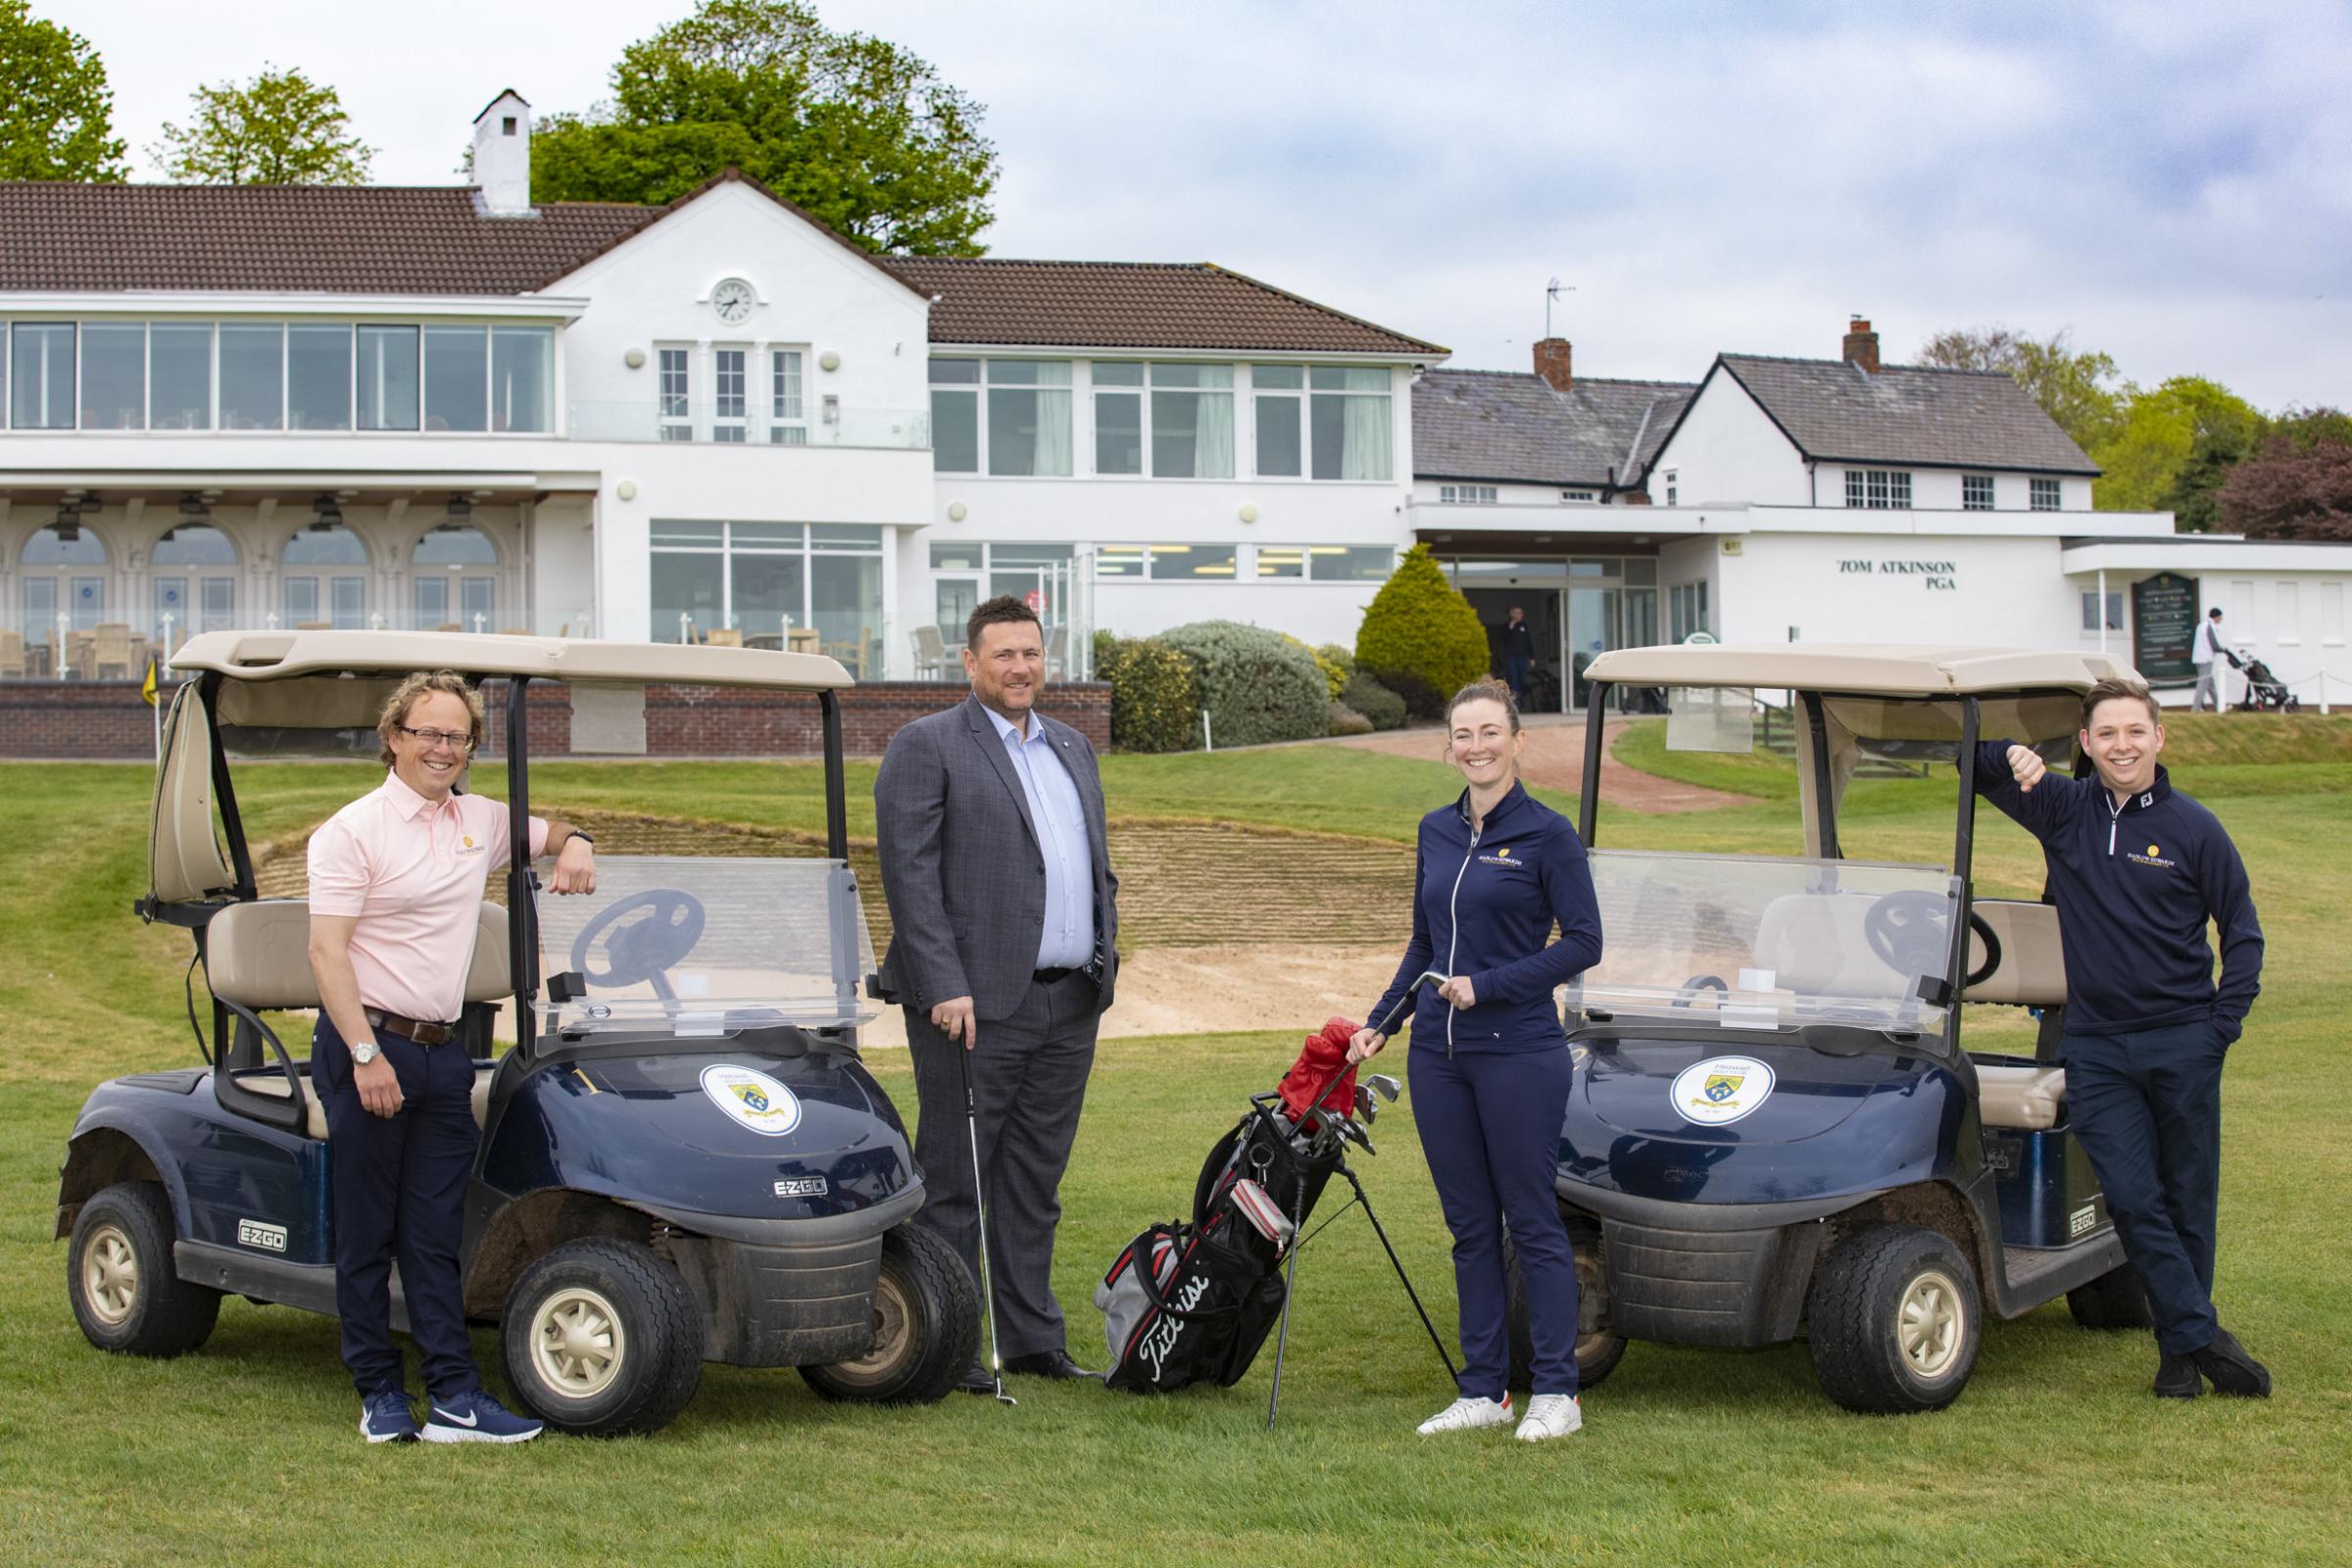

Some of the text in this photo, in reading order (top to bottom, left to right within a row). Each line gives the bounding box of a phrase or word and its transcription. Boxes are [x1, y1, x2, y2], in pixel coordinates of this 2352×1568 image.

[1837, 560, 1956, 574] TOM ATKINSON
[1926, 576, 1956, 590] PGA
[2139, 791, 2154, 808] FJ
